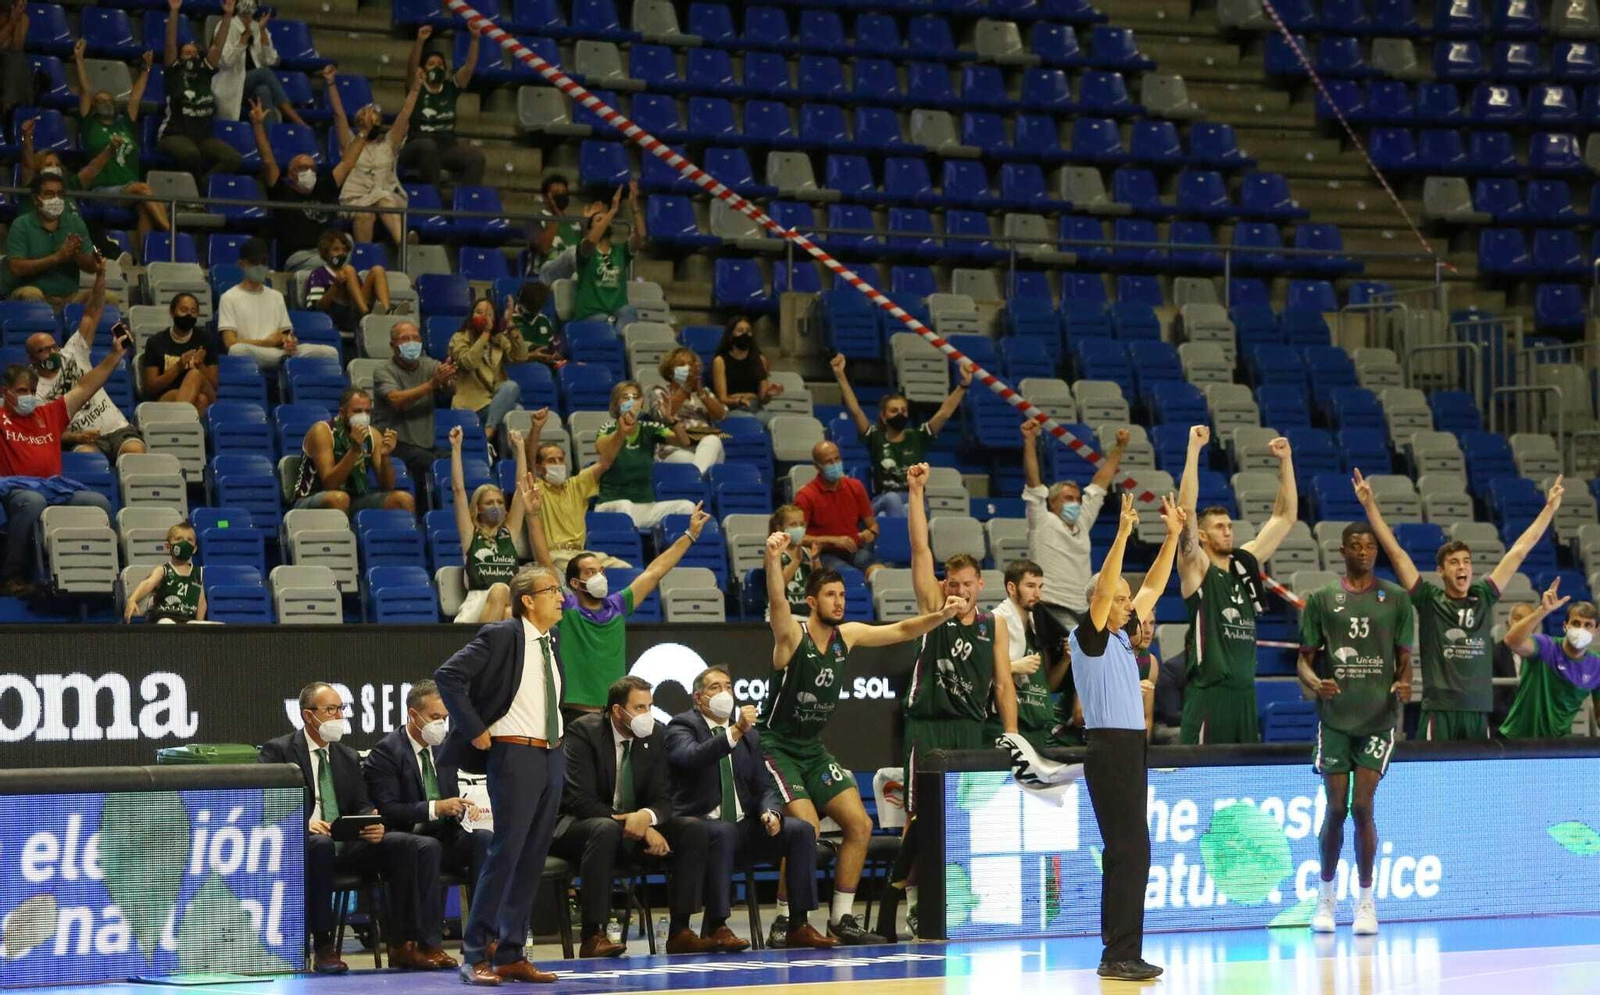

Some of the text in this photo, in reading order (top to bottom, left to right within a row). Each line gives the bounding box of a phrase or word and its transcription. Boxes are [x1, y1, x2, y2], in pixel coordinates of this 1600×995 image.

[177, 582, 189, 596] 21
[1348, 617, 1370, 638] 33
[1457, 608, 1474, 628] 16
[950, 637, 973, 660] 99
[1355, 655, 1384, 667] Unicaja
[733, 678, 769, 701] CO
[853, 676, 895, 699] SOL
[1364, 736, 1387, 759] 33
[829, 763, 847, 781] 8
